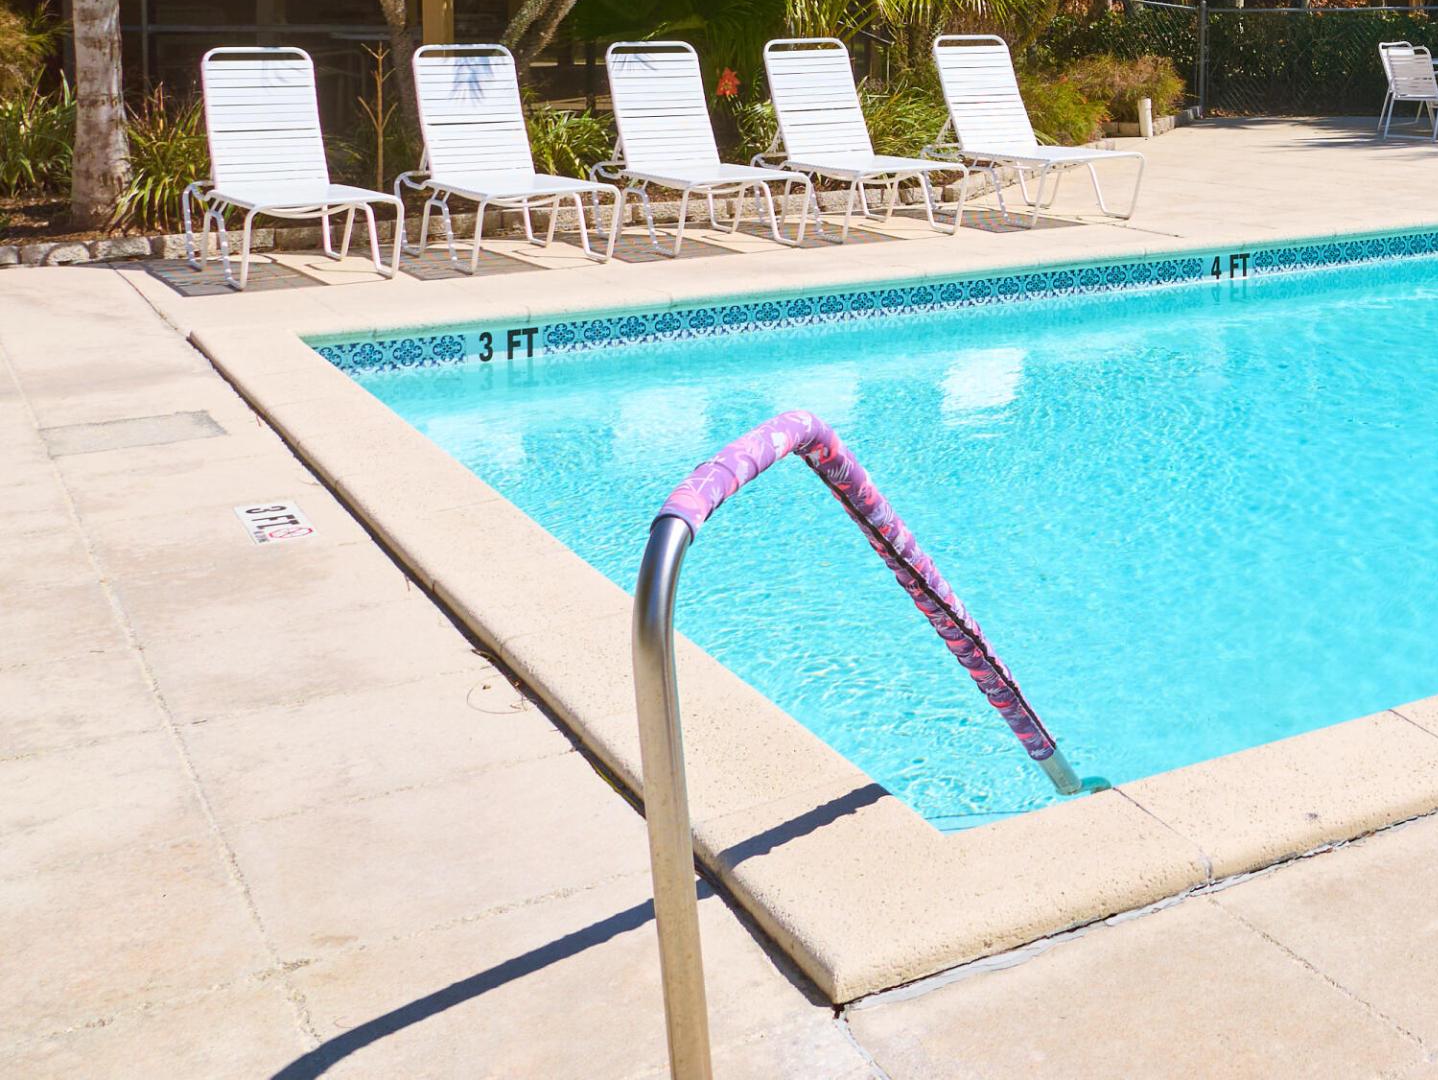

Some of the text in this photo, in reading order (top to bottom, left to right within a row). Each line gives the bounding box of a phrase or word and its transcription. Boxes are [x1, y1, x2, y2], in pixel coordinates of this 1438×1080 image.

[1211, 253, 1250, 279] 4 FT
[479, 327, 538, 362] 3 FT
[245, 505, 287, 514] 3
